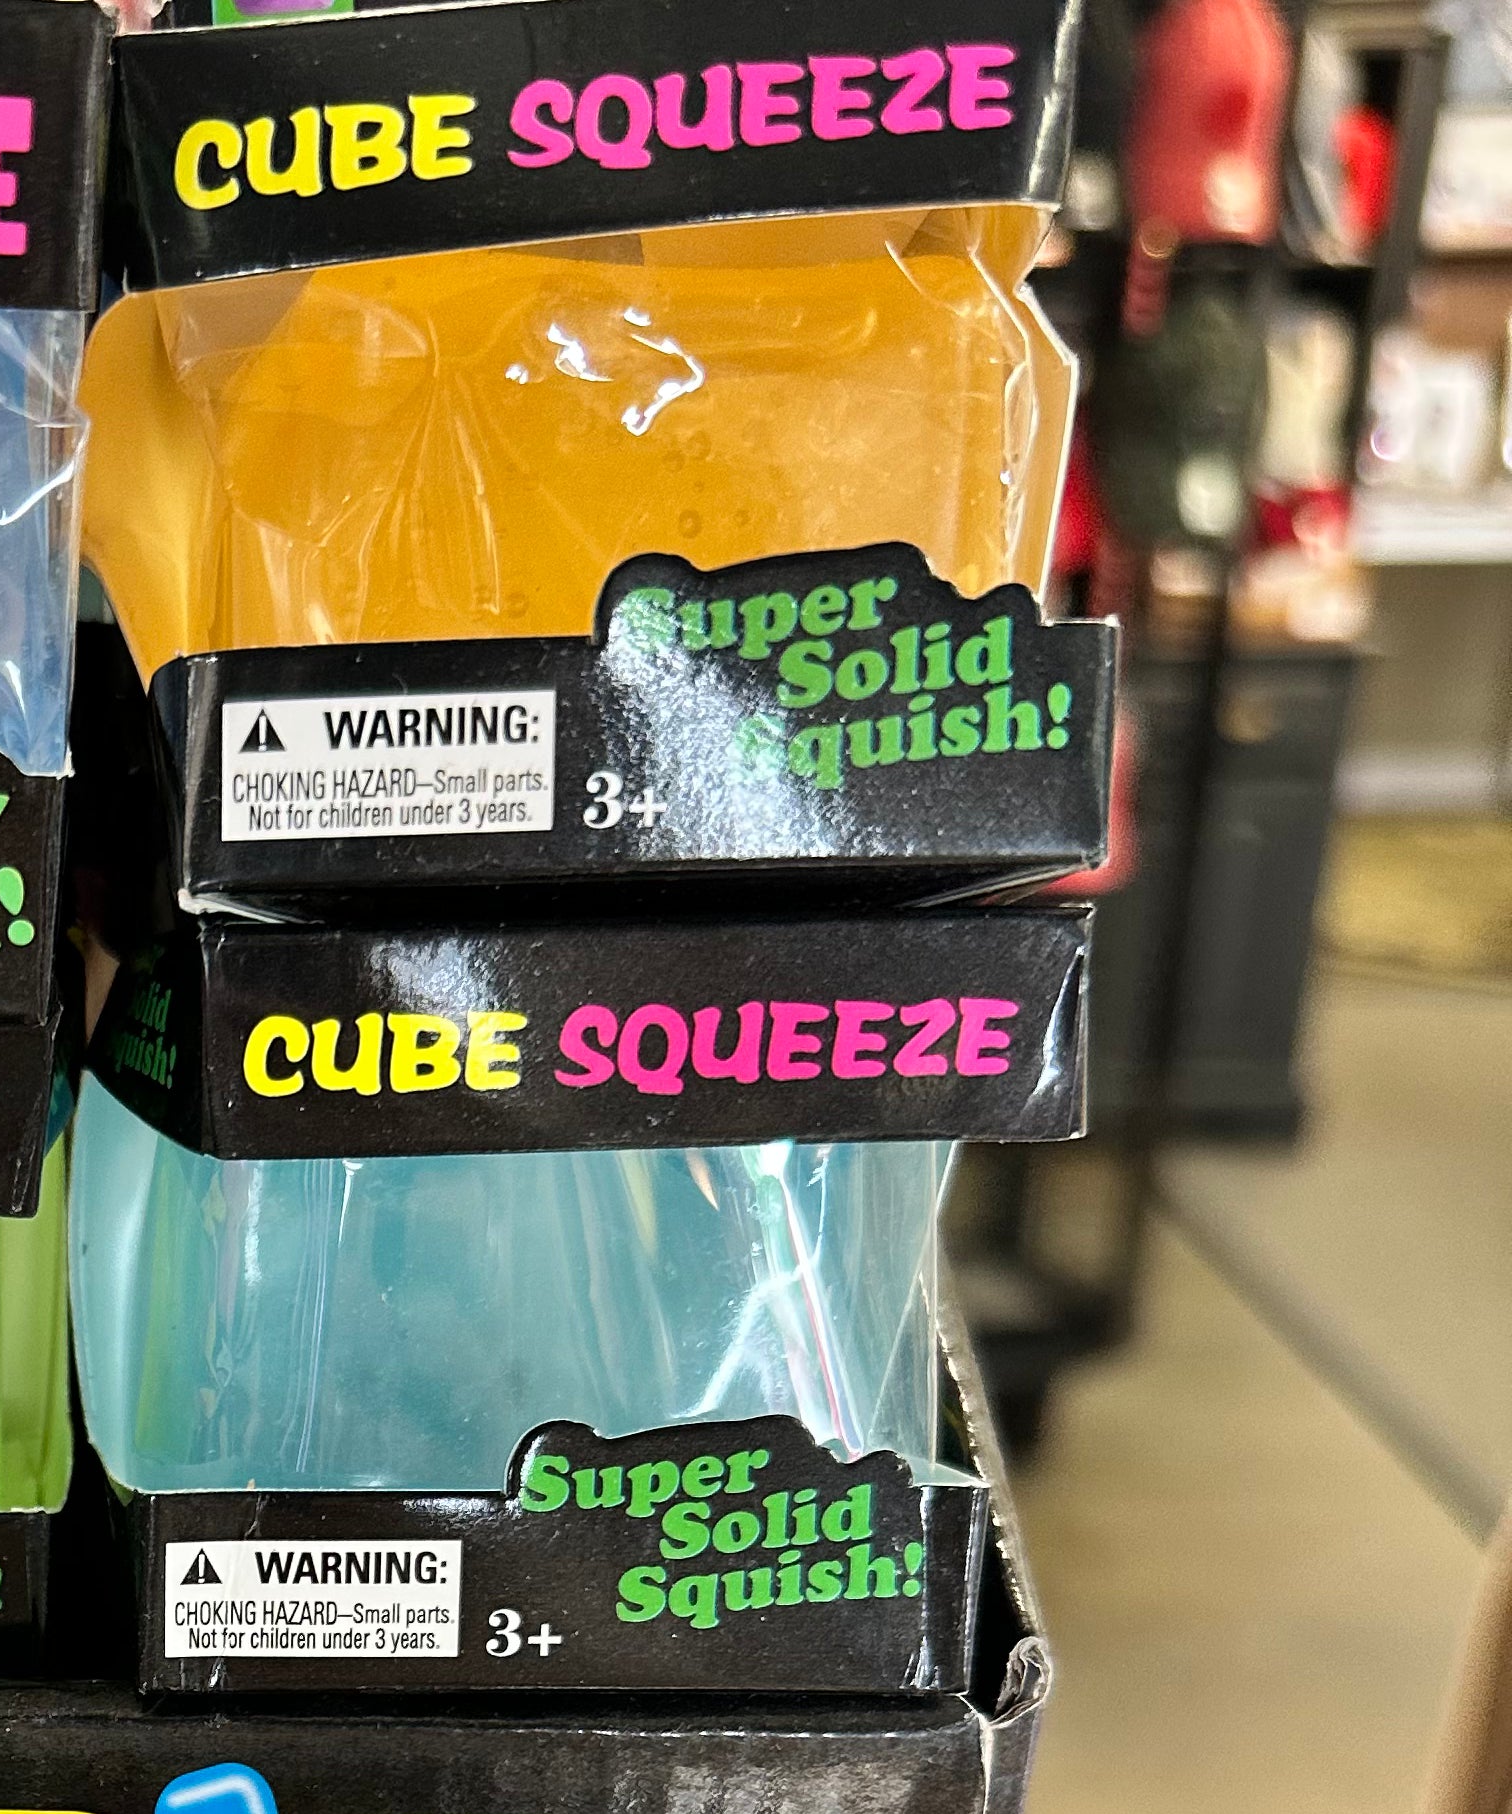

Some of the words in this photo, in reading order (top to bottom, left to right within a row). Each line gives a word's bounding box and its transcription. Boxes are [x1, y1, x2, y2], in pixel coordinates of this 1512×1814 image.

[174, 94, 478, 210] CUBE
[508, 43, 1016, 170] SQUEEZE
[776, 614, 1015, 709] Solid
[323, 704, 540, 750] WARNING:
[232, 771, 326, 803] CHOKING
[492, 769, 549, 799] parts.
[582, 770, 668, 830] 3+
[248, 803, 281, 831] Not
[285, 802, 313, 829] for
[319, 801, 392, 829] children
[399, 800, 453, 826] under
[458, 799, 471, 825] 3
[475, 801, 533, 831] years.
[243, 1010, 529, 1098] CUBE
[553, 997, 1020, 1095] SQUEEZE
[519, 1447, 771, 1520] Super
[658, 1482, 873, 1562] Solid
[255, 1550, 448, 1585] WARNING:
[614, 1541, 927, 1630] Squish!
[174, 1601, 257, 1627] CHOKING
[405, 1605, 456, 1628] parts.
[188, 1629, 219, 1650] Not
[220, 1628, 247, 1650] for
[249, 1628, 317, 1650] children
[322, 1629, 371, 1650] under
[375, 1630, 387, 1650] 3
[390, 1631, 441, 1655] years.
[485, 1607, 563, 1658] 3+
